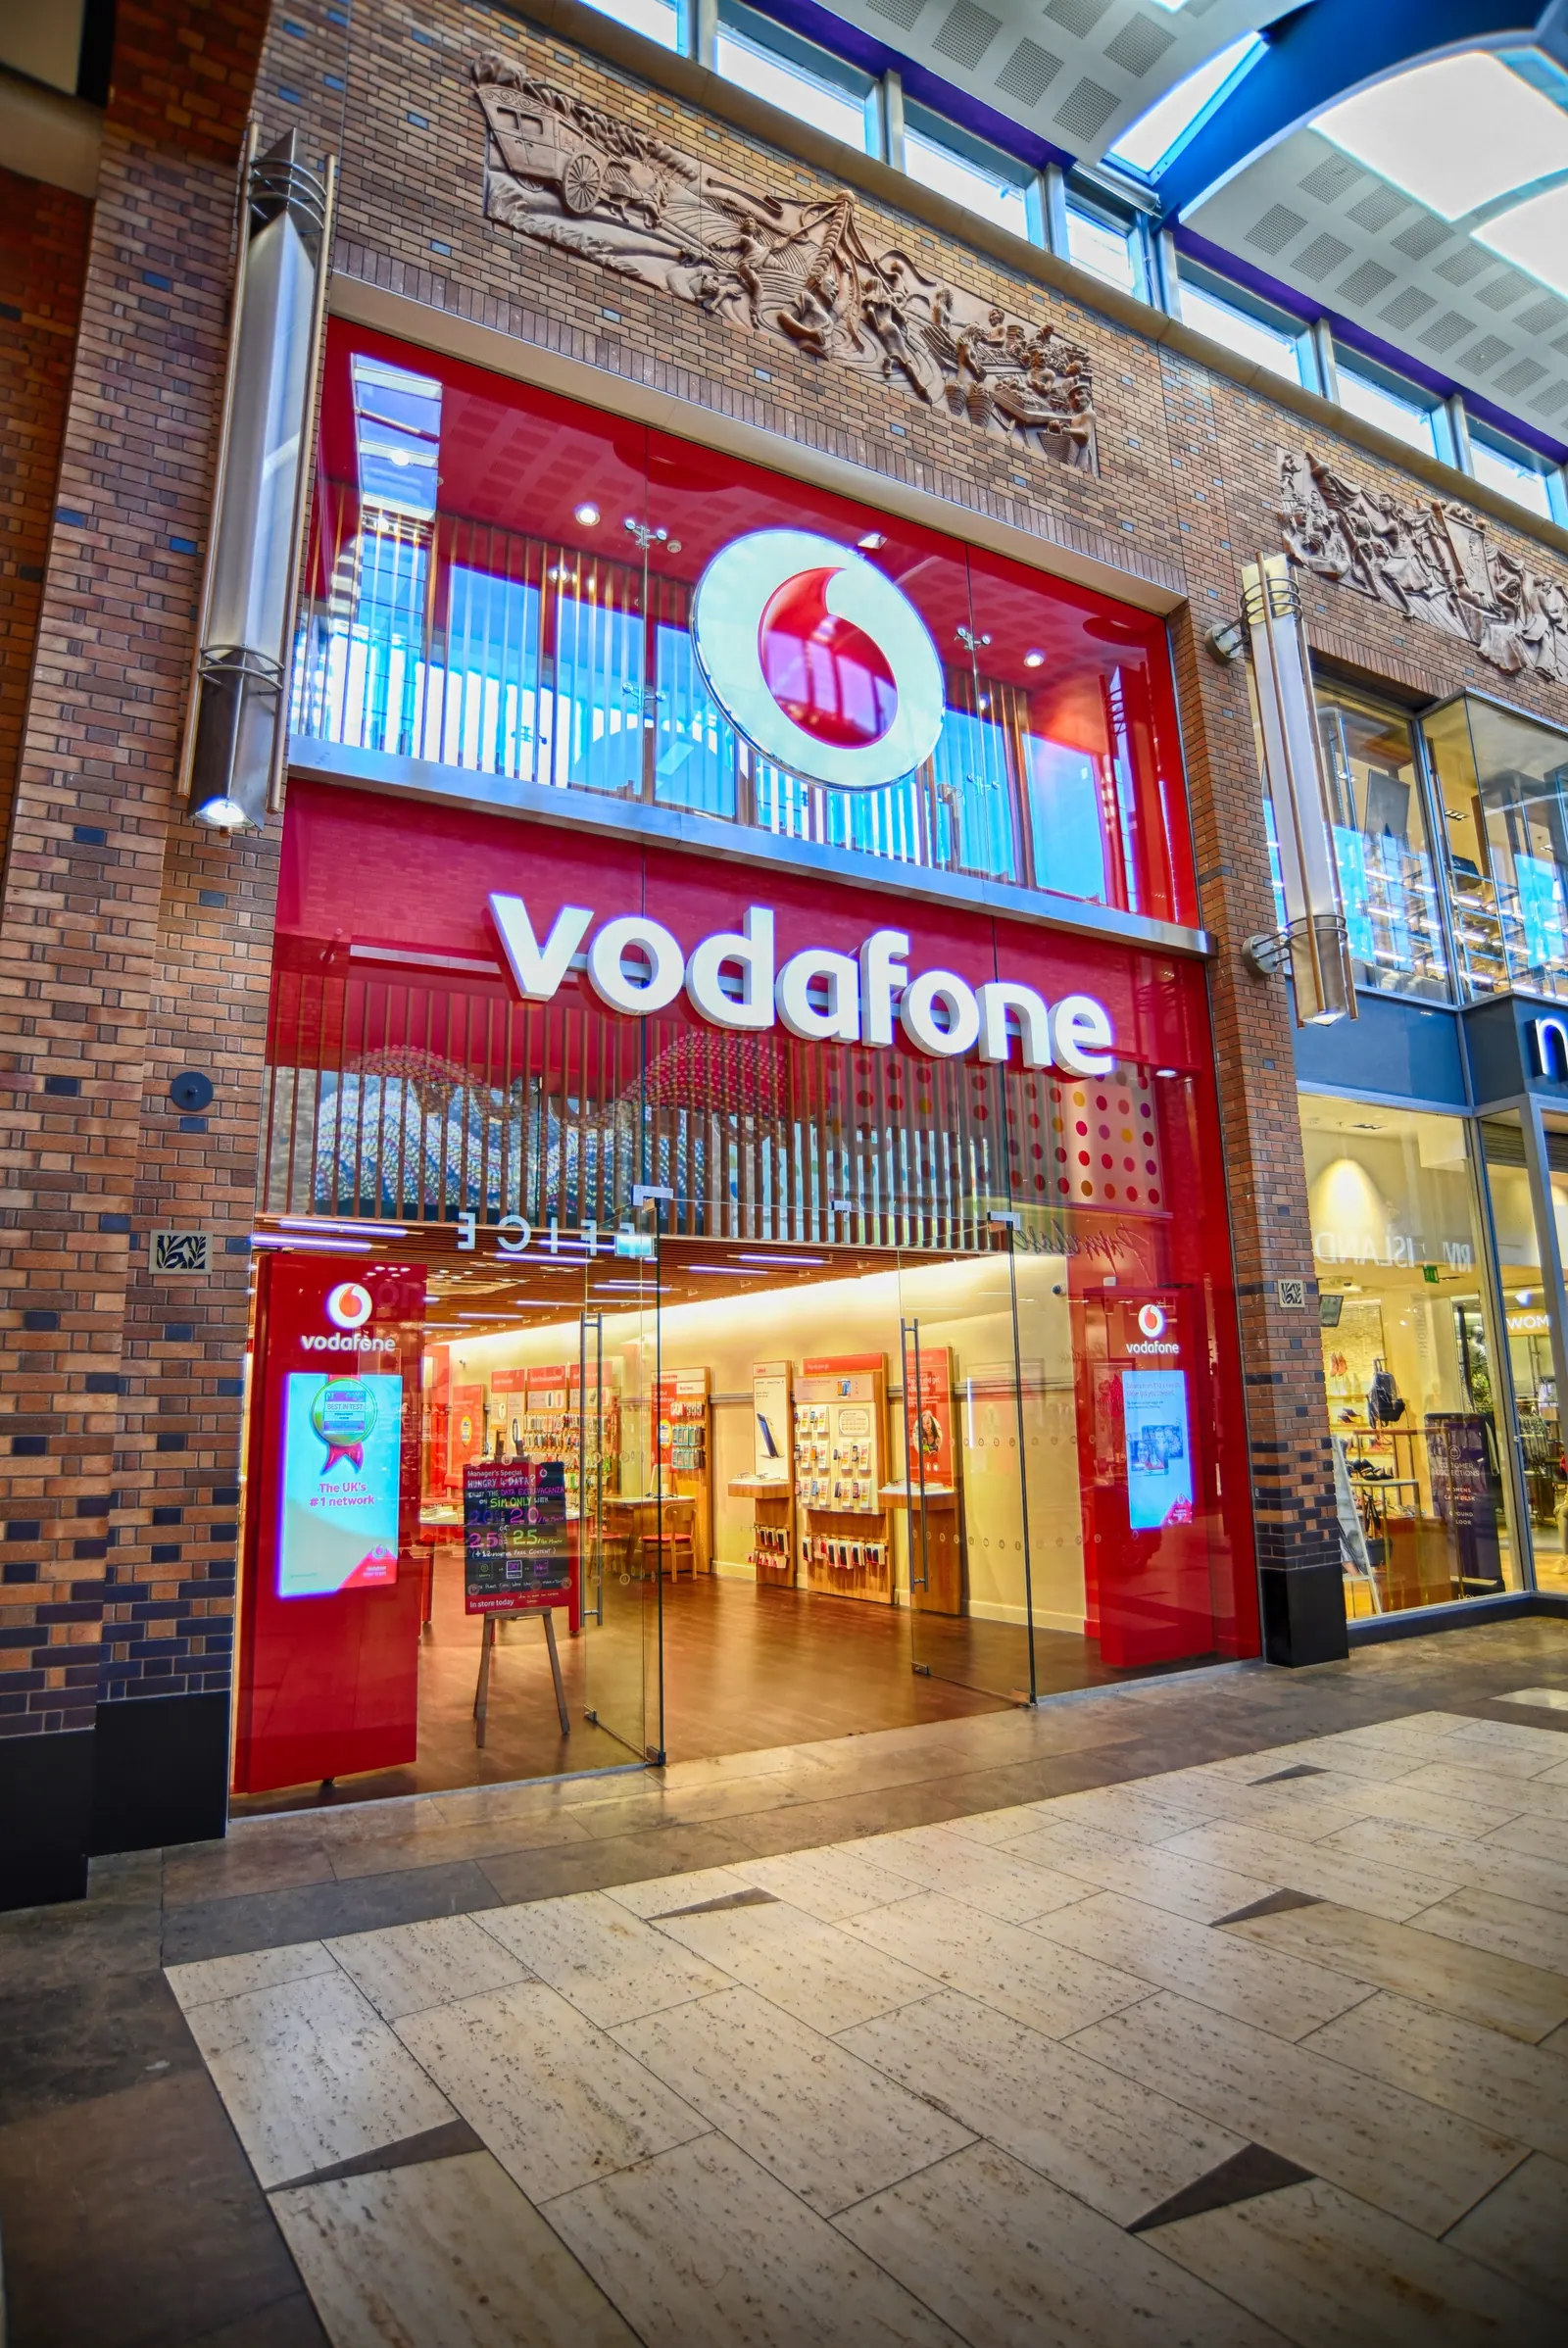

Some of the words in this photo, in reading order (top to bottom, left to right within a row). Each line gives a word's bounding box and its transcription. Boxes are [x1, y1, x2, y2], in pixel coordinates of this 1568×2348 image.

[490, 893, 1115, 1077] vodafone
[301, 1332, 396, 1351] vodafone
[1126, 1341, 1179, 1353] vodafone
[467, 1470, 499, 1479] Manager's
[500, 1468, 522, 1478] Special
[319, 1483, 340, 1493] The
[342, 1482, 367, 1492] UK's
[467, 1478, 496, 1489] HUNGRY
[329, 1495, 374, 1506] network
[510, 1496, 532, 1507] ONLY
[514, 1529, 538, 1544] 25
[496, 1598, 514, 1607] today
